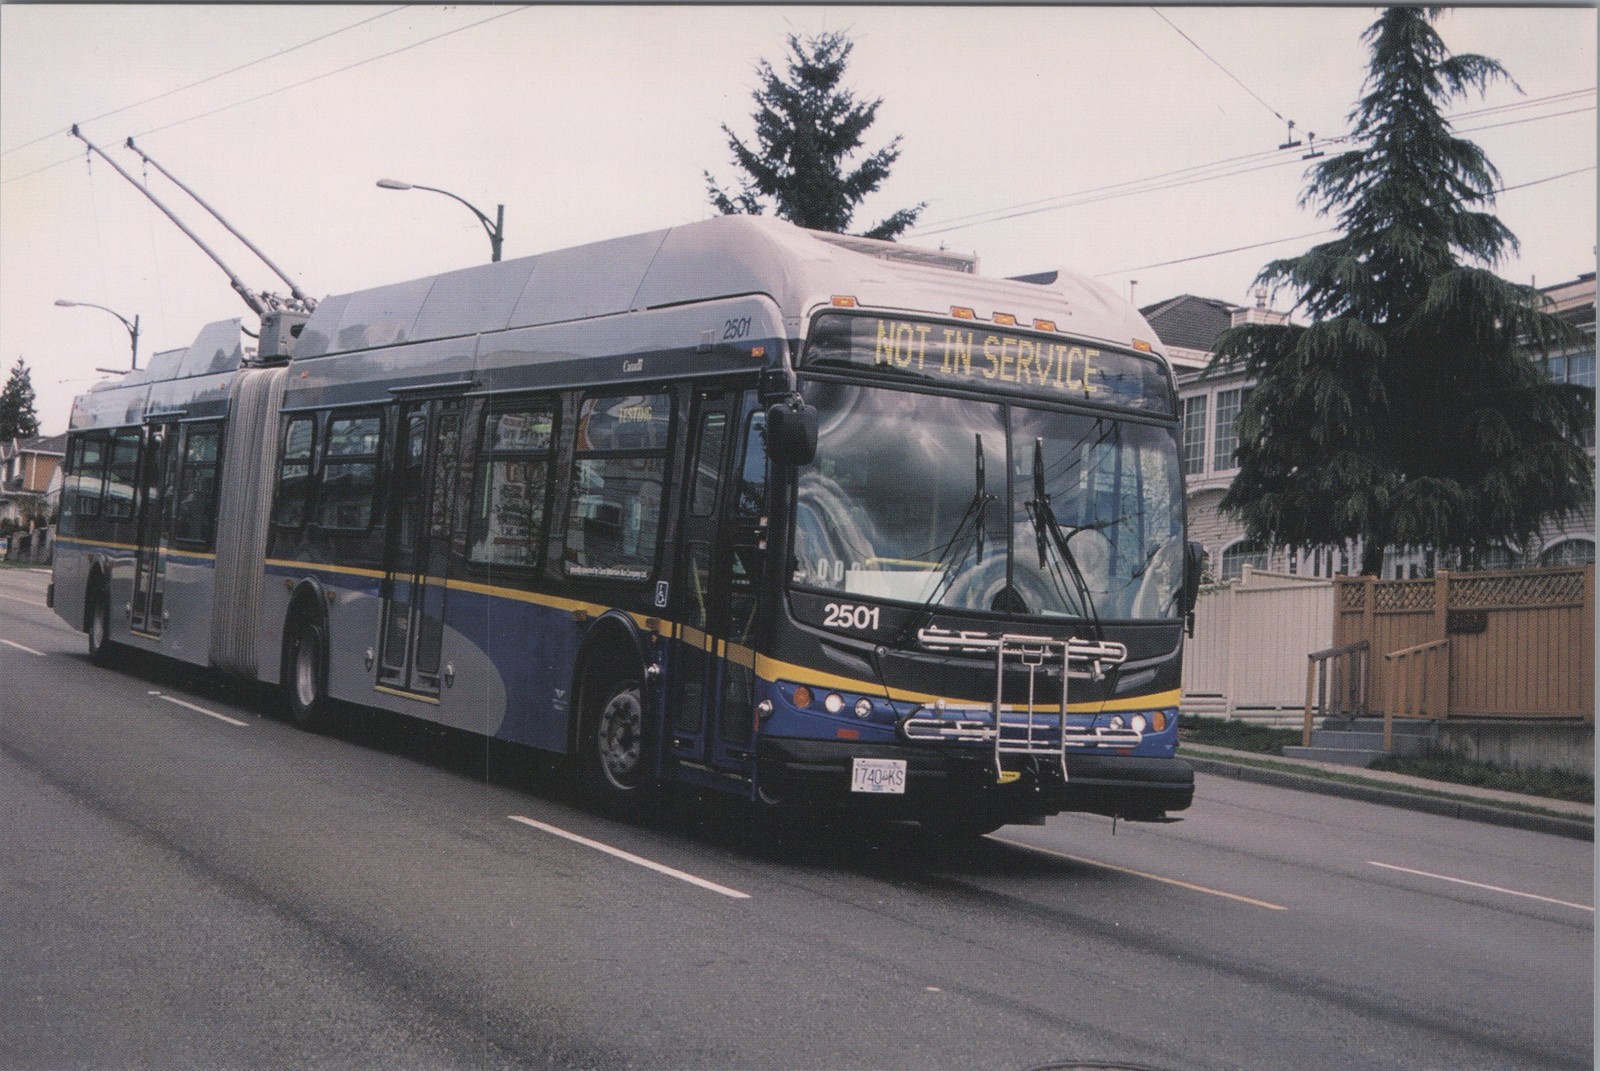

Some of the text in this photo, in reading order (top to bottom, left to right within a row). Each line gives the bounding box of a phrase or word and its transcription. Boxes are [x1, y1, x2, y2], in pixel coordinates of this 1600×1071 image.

[723, 317, 752, 340] 2501
[874, 319, 1100, 392] NOT IN SERVICE
[617, 406, 653, 424] TESTING
[823, 602, 880, 630] 2501
